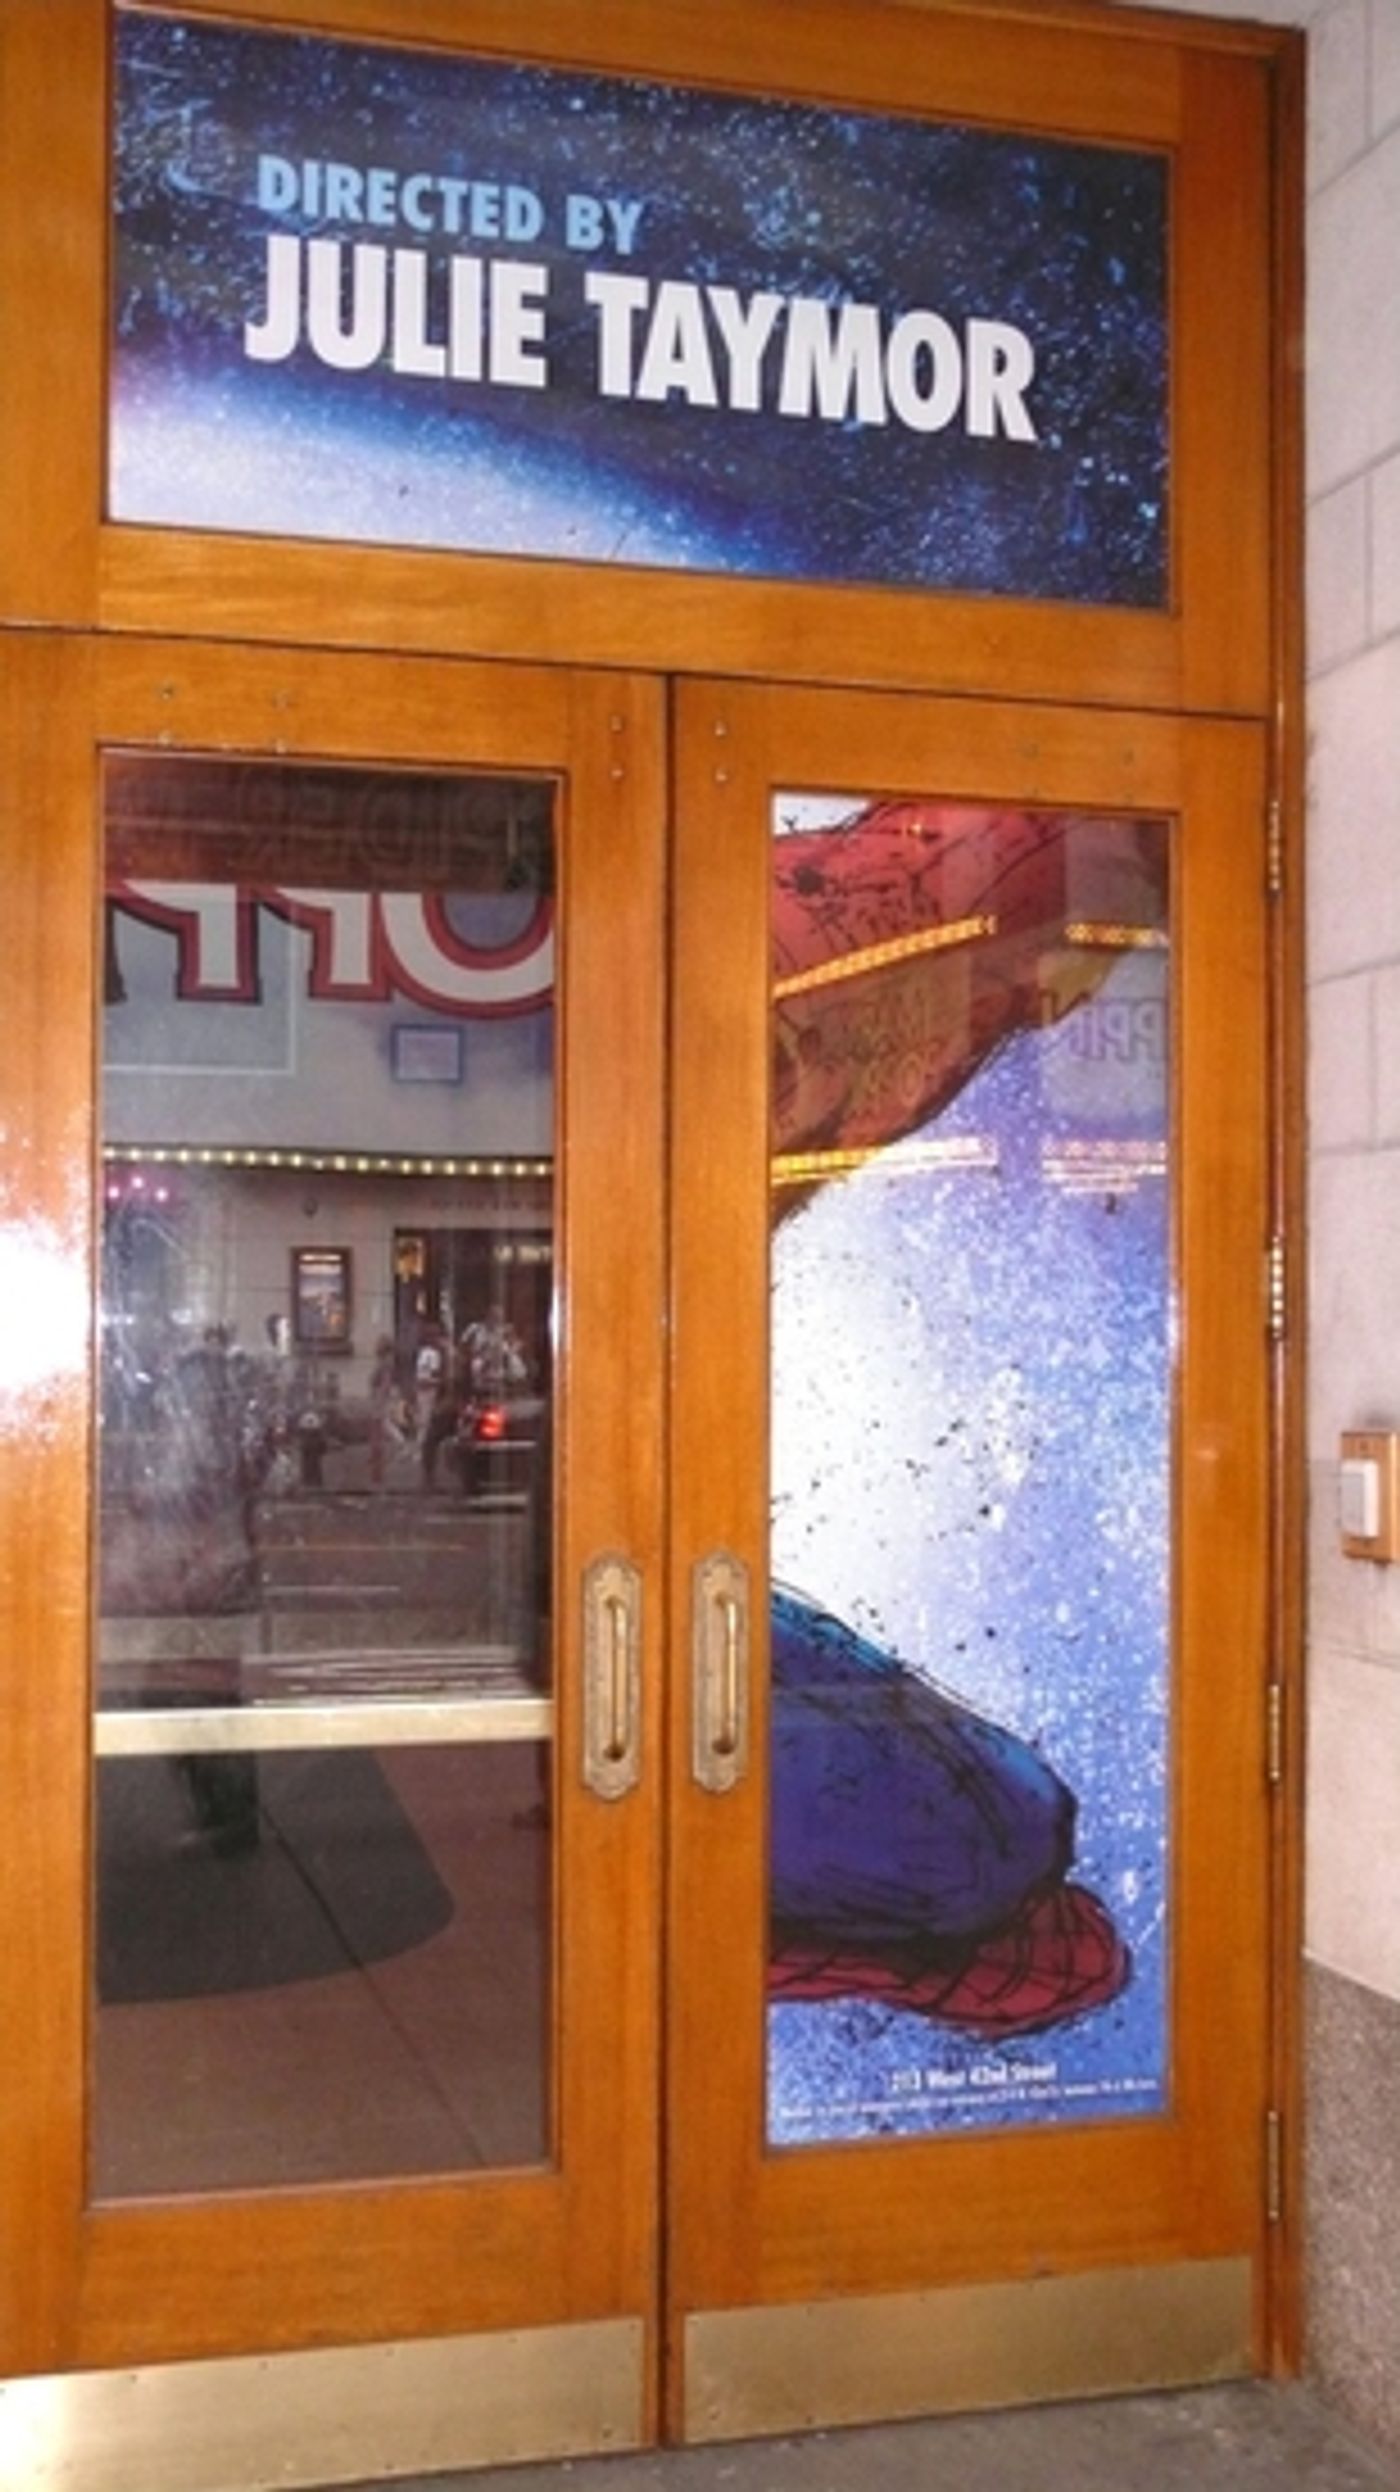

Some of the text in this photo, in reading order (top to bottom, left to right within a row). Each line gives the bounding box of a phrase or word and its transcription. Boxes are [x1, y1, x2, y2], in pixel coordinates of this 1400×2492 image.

[257, 153, 643, 256] DIRECTED BY
[243, 233, 1039, 442] JULIE TAYMOR
